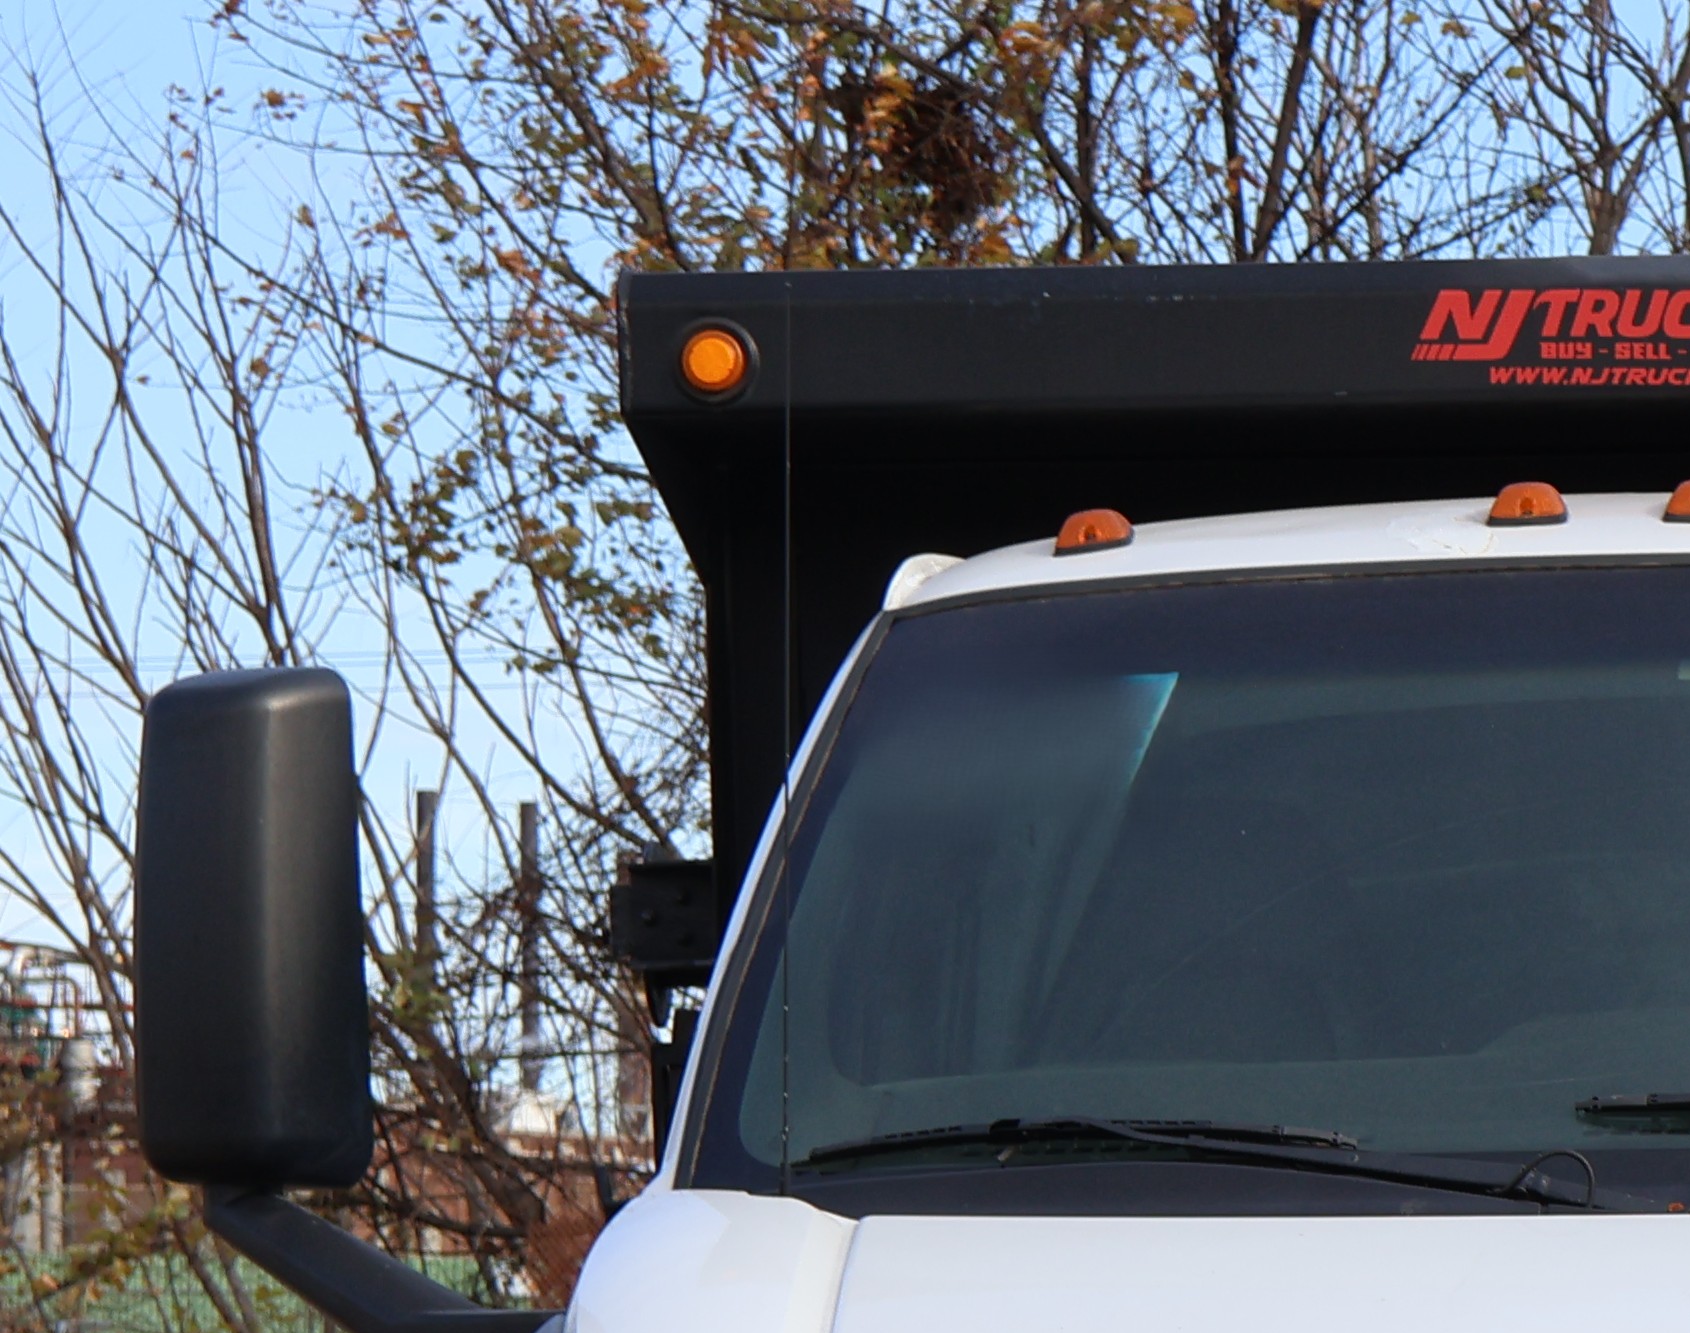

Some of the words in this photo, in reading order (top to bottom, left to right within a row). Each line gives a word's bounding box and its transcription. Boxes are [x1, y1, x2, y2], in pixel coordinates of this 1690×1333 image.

[1413, 289, 1536, 361] NJ
[1539, 341, 1594, 360] BUY
[1614, 342, 1673, 361] SELL
